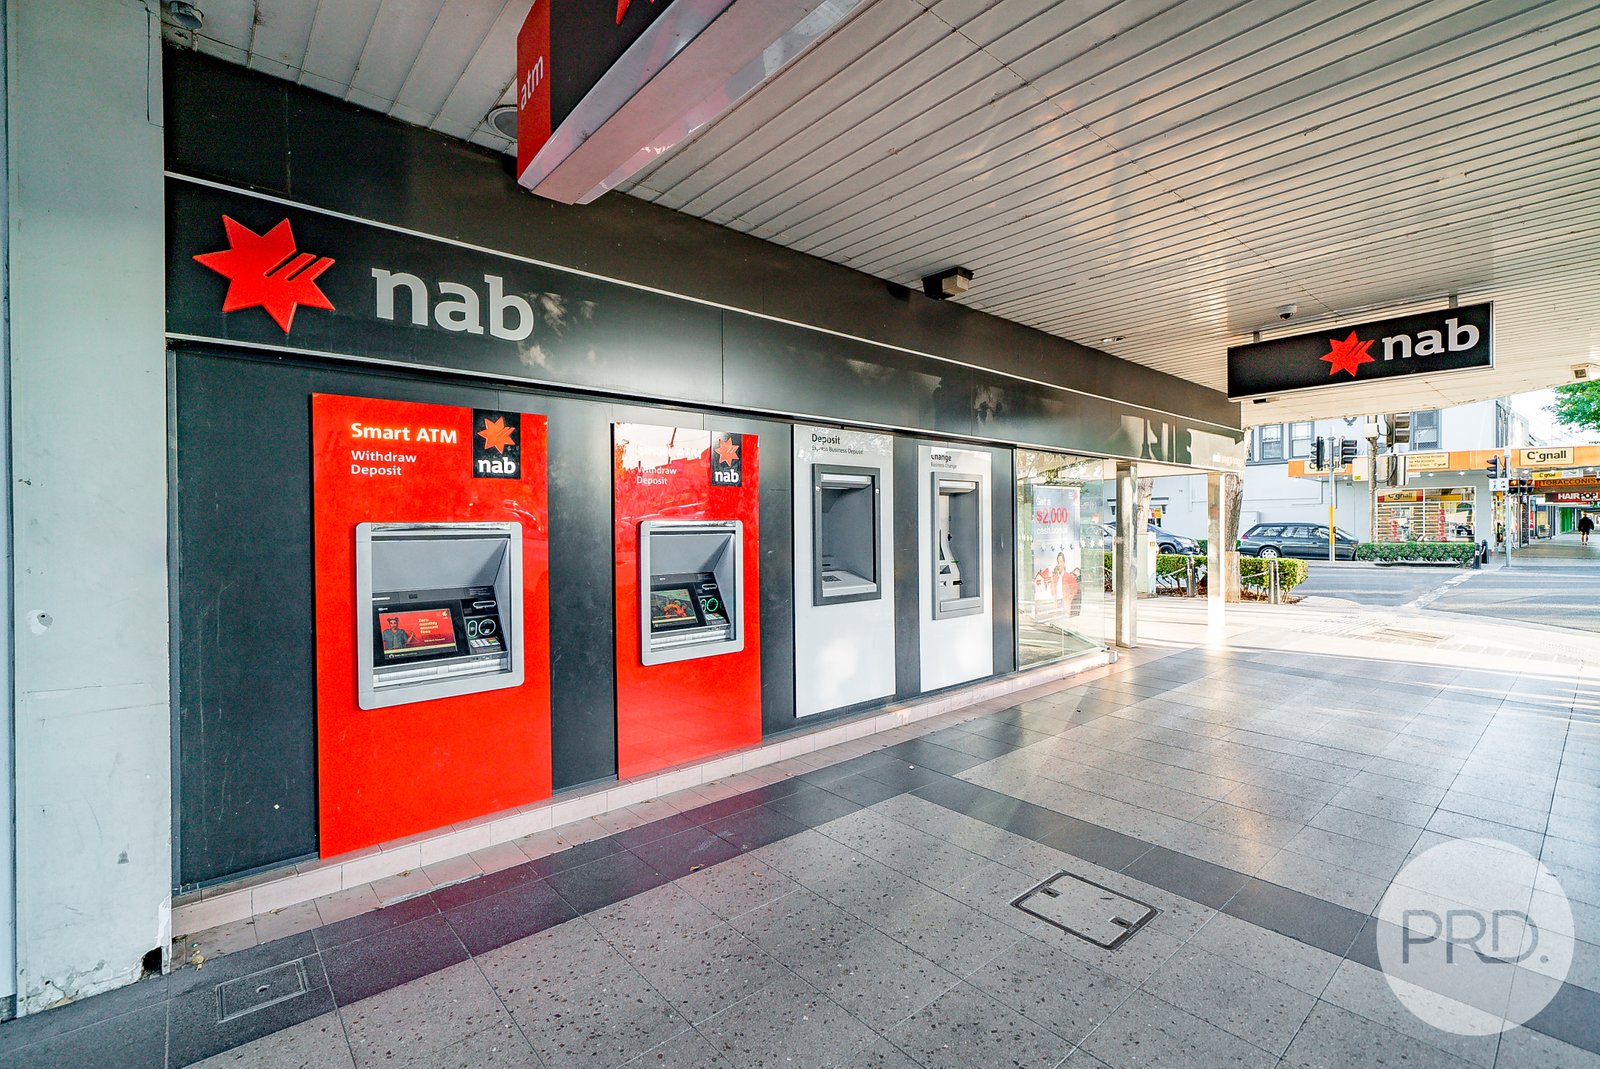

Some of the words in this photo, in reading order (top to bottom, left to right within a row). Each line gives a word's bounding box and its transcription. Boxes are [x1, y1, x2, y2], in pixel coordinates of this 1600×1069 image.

[520, 55, 545, 111] atm
[371, 267, 535, 342] nab
[1381, 317, 1480, 361] nab
[351, 422, 411, 441] Smart
[415, 427, 458, 444] ATM
[811, 433, 841, 446] Deposit
[351, 450, 417, 463] Withdraw
[351, 464, 402, 477] Deposit
[477, 456, 517, 475] nab
[637, 466, 678, 475] Withdraw
[636, 475, 668, 486] Deposit
[714, 468, 740, 483] nab
[1557, 492, 1580, 500] HAIR
[1036, 507, 1068, 525] $2,000
